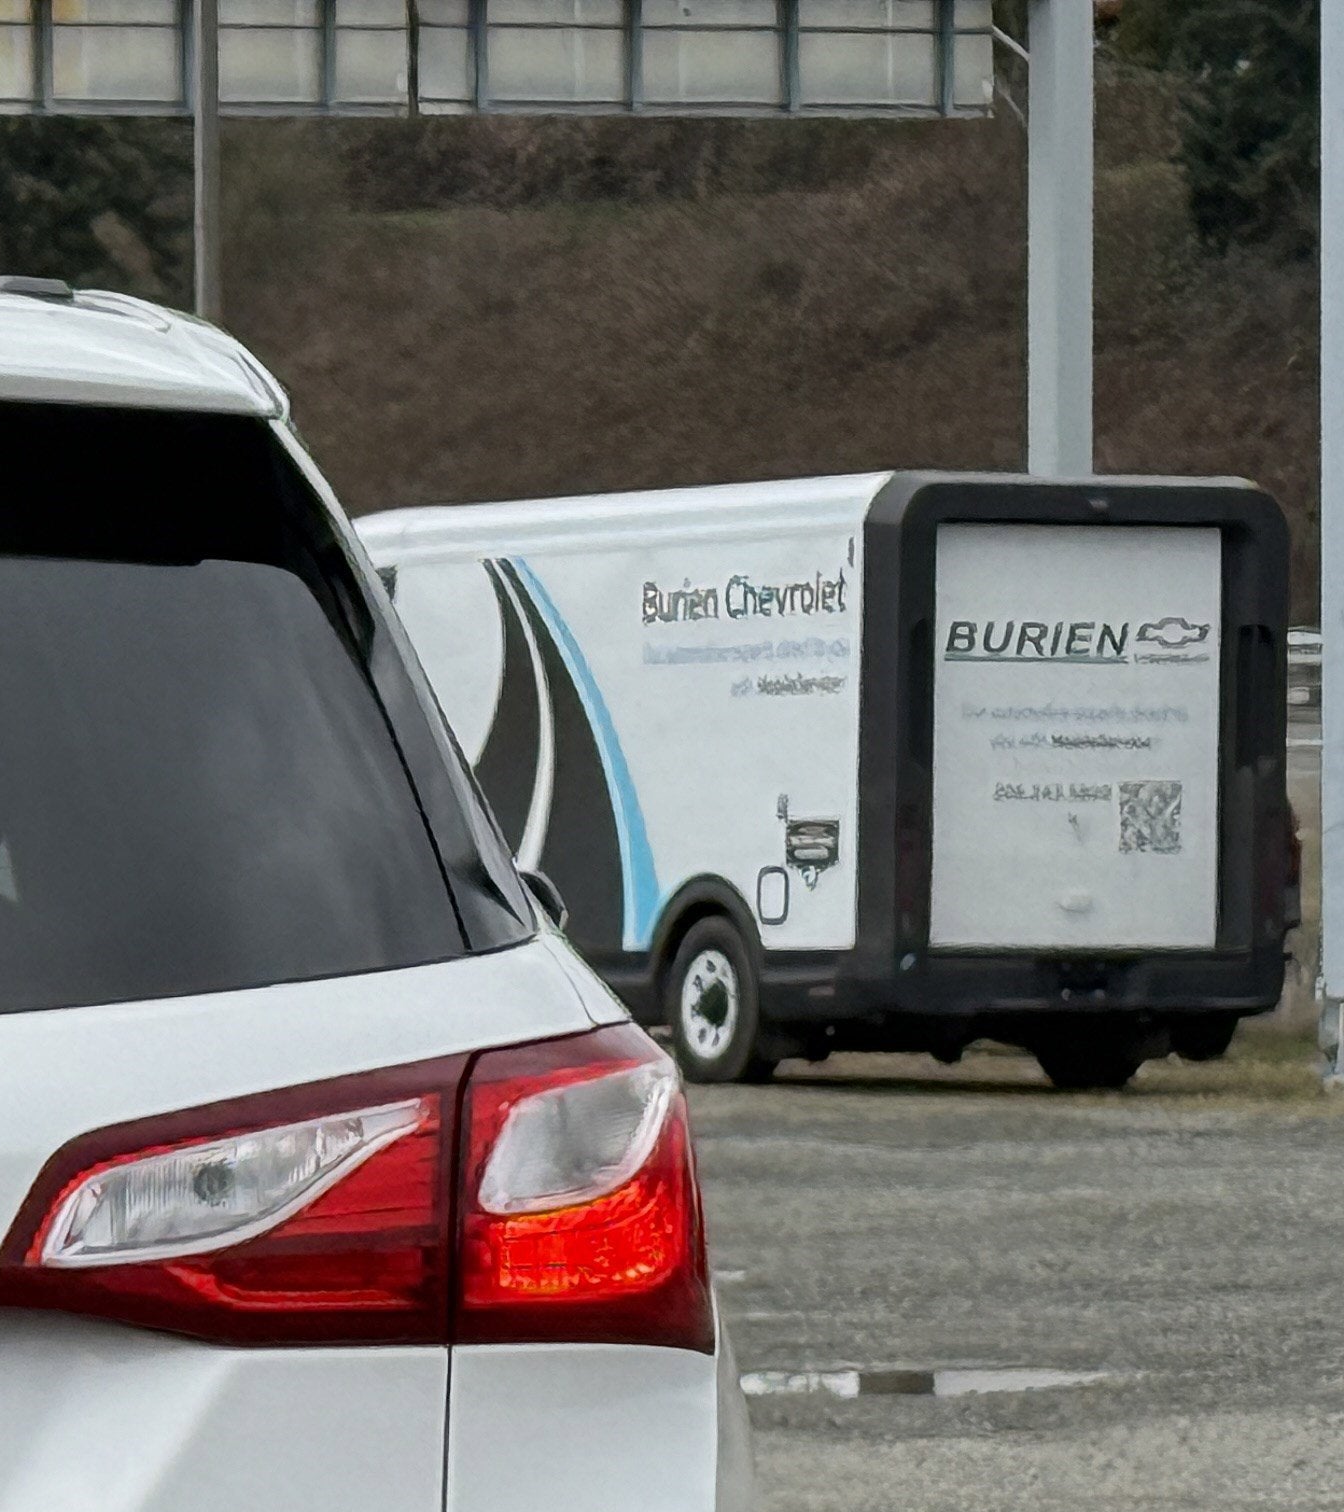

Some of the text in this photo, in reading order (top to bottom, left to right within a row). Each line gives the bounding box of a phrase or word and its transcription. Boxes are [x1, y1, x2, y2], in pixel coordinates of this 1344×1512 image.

[643, 567, 847, 625] Burien Chevrolet
[945, 620, 1129, 657] BURIEN
